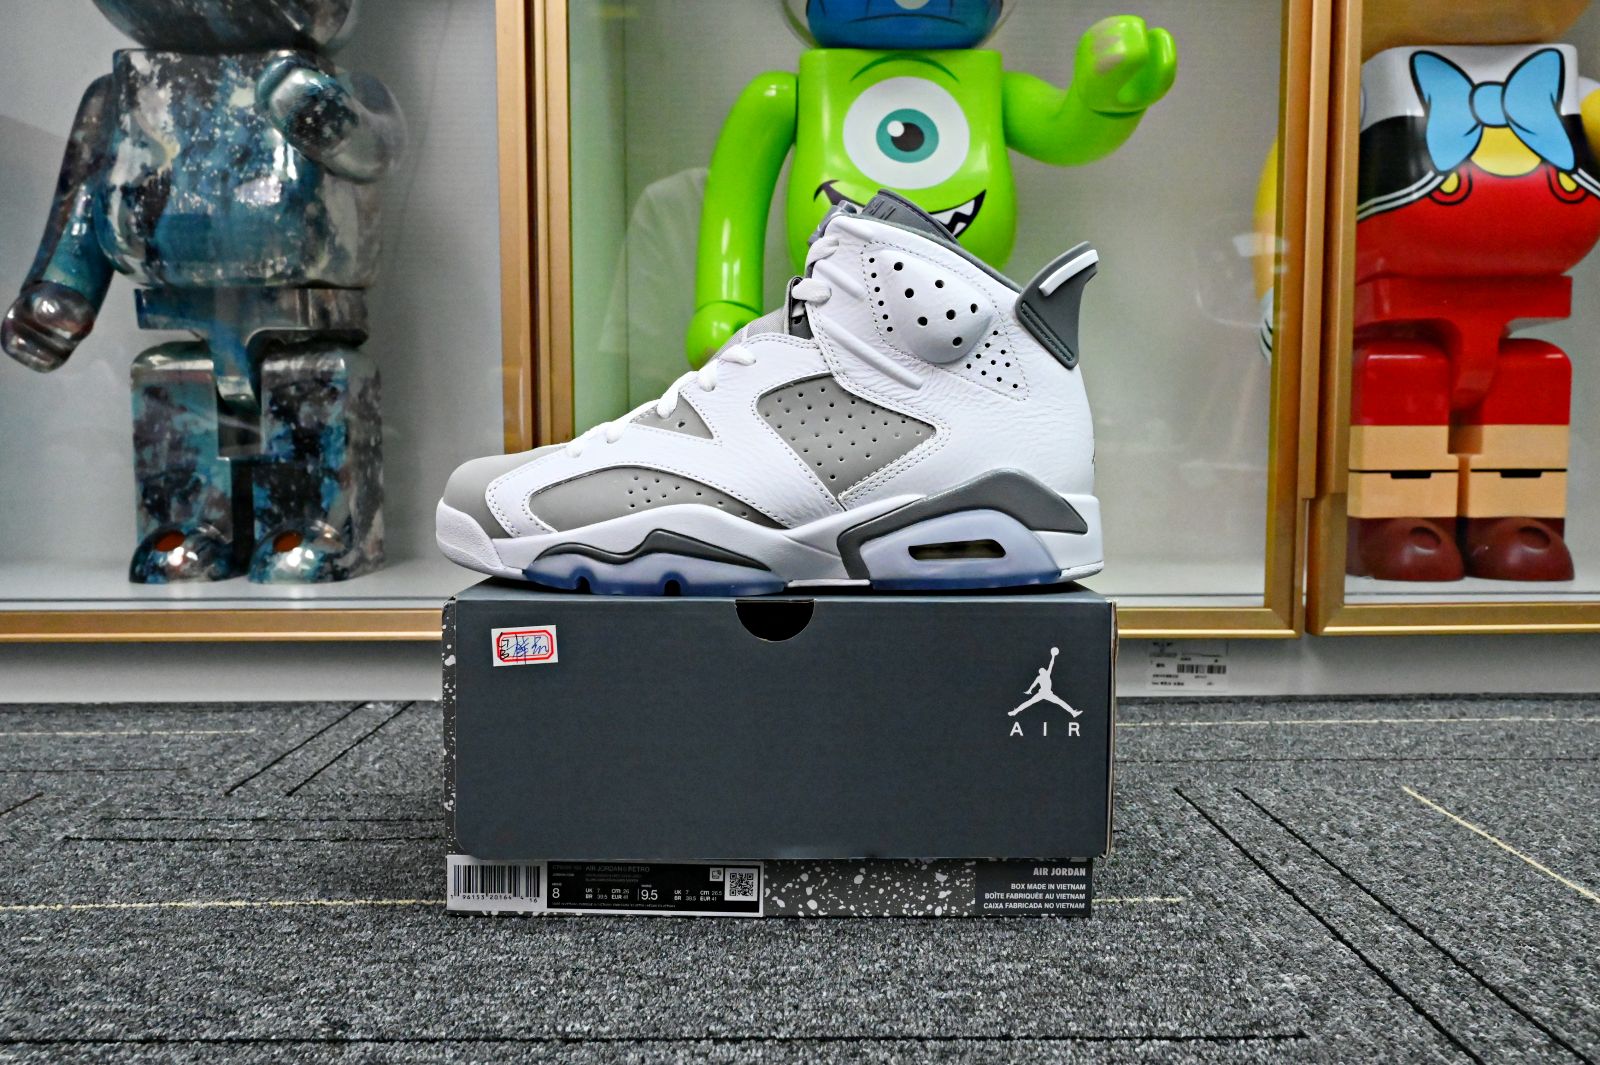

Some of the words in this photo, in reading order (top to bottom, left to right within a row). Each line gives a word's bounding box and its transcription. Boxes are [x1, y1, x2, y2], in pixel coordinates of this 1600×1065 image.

[1009, 721, 1081, 737] AIR
[1033, 867, 1048, 876] AIR
[1050, 867, 1086, 876] JORDAN
[552, 887, 560, 899] 8
[641, 889, 658, 901] 9.5
[984, 891, 1005, 900] BOÎTE
